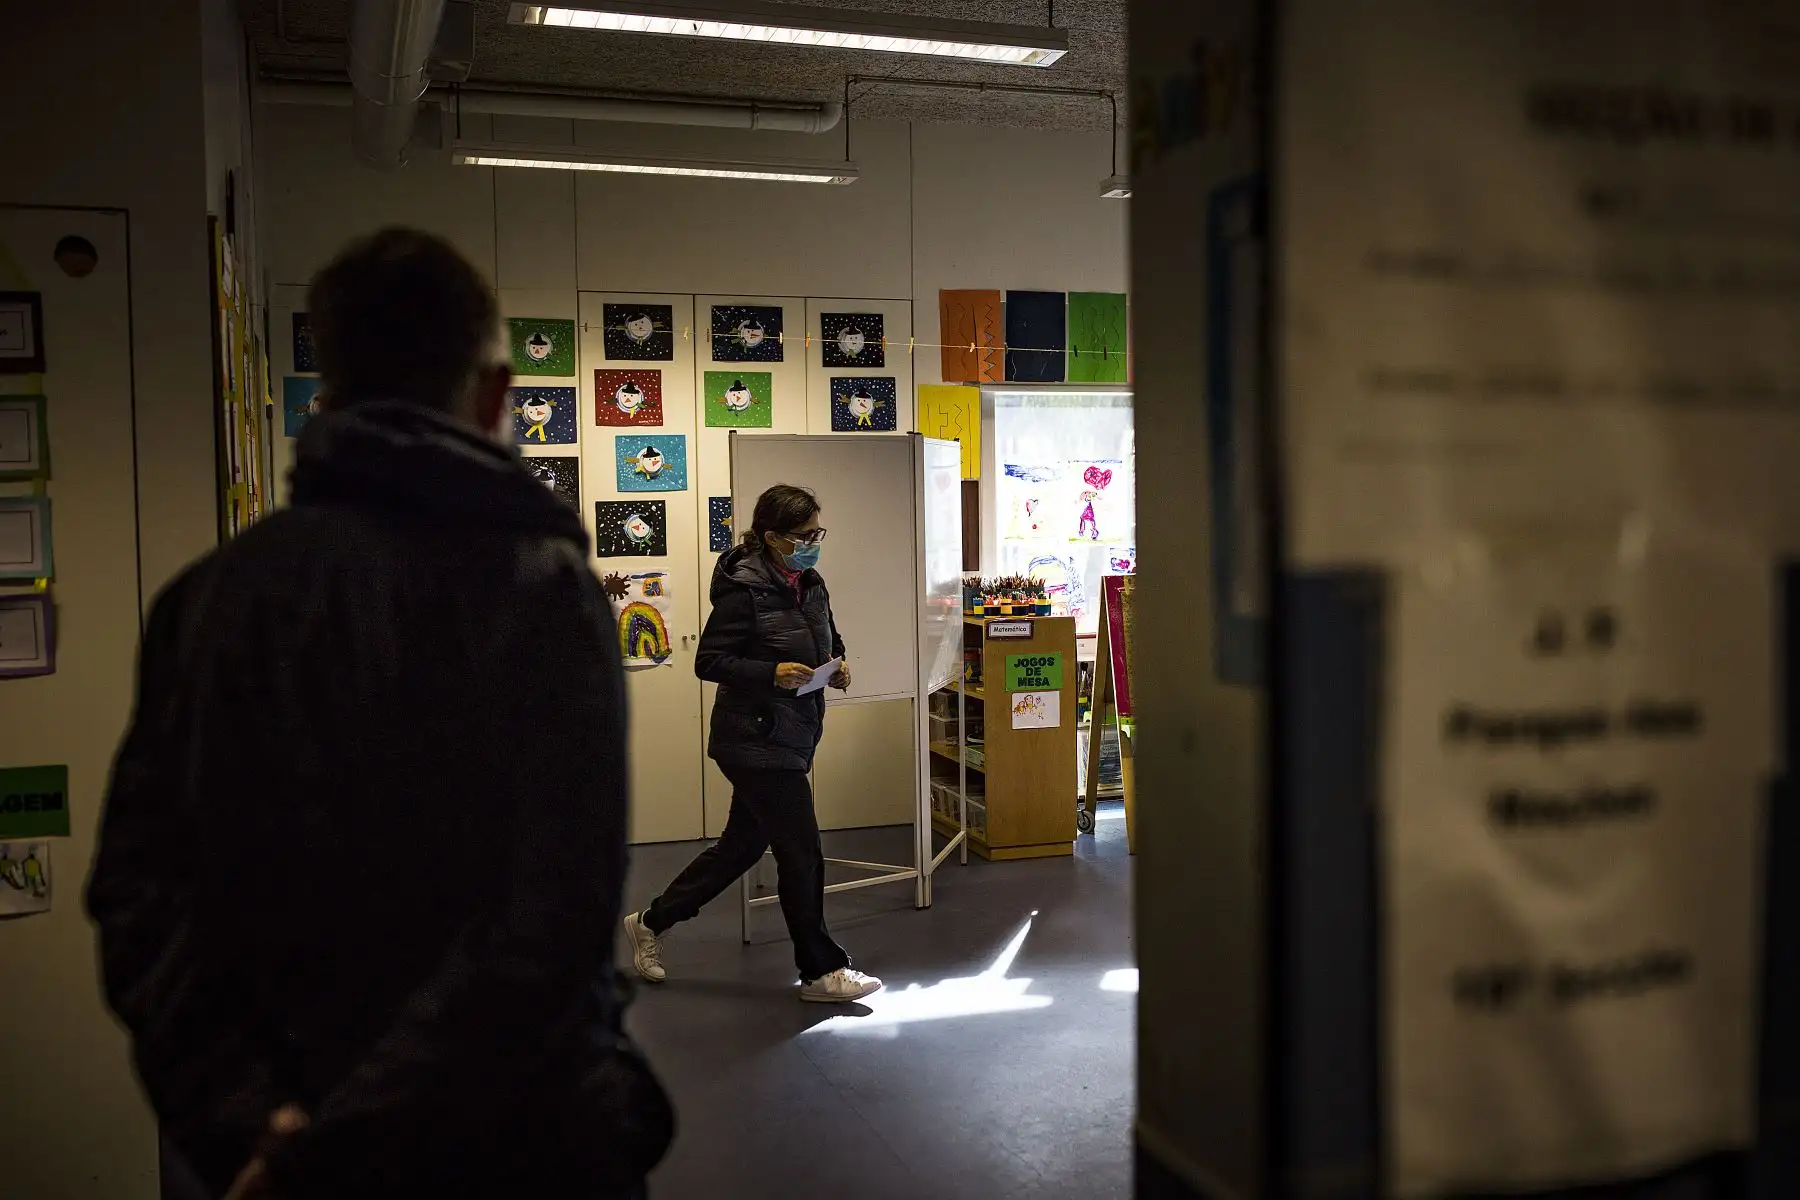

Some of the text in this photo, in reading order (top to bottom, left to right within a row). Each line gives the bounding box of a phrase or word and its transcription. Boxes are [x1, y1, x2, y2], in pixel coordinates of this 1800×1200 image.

[1013, 656, 1055, 667] JOGOS
[1025, 667, 1042, 676] DE
[1017, 676, 1050, 687] MESA
[0, 791, 62, 812] GEM
